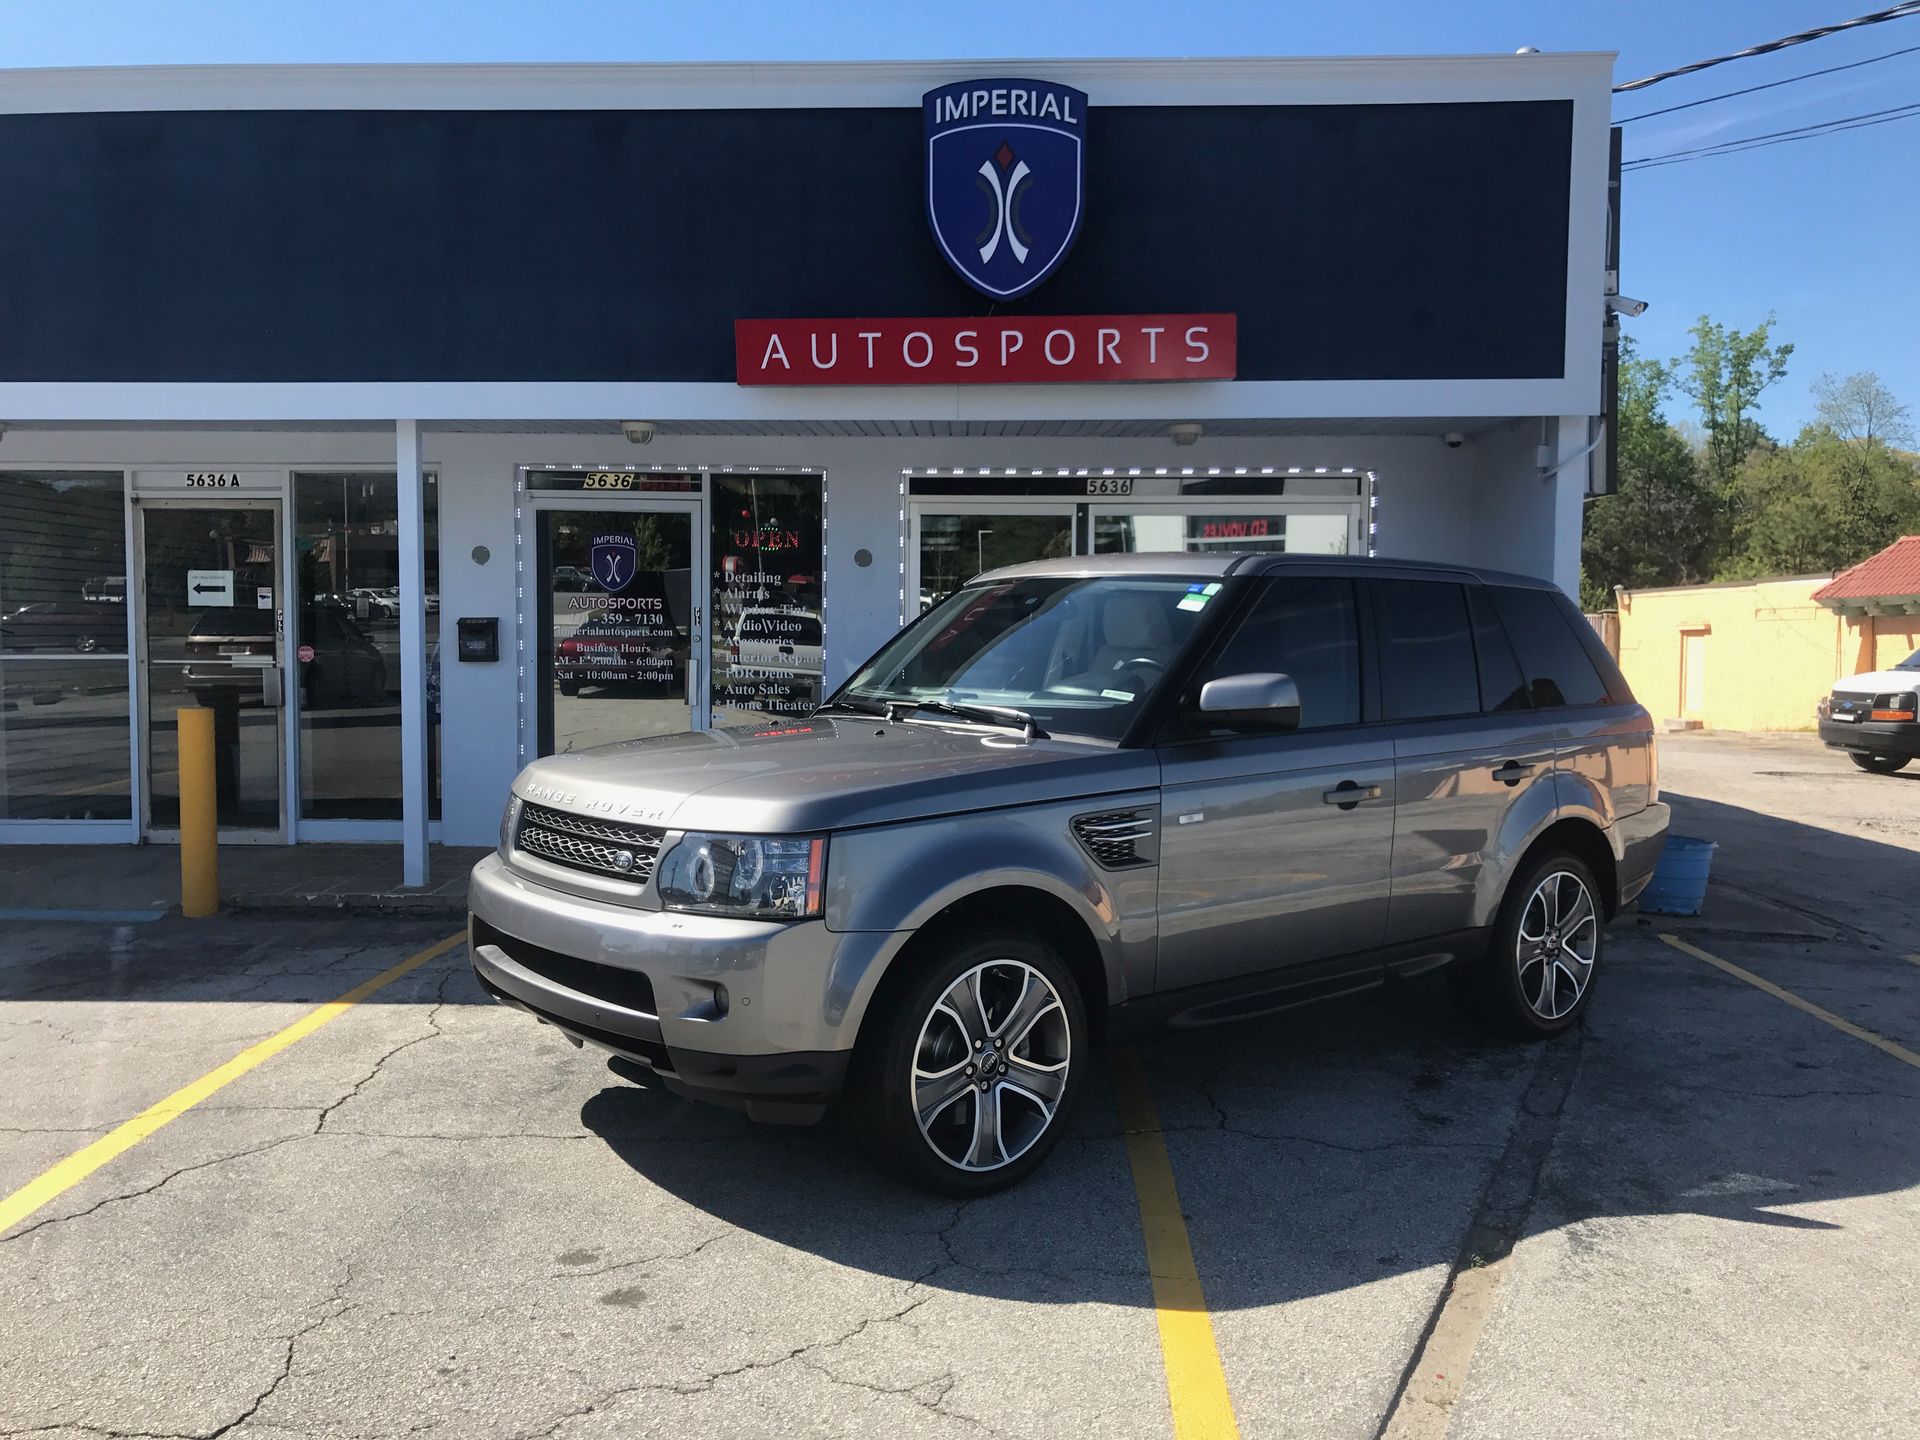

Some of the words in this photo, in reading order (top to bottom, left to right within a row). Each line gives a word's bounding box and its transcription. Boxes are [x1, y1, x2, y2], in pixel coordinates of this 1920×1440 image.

[935, 89, 1078, 124] IMPERIAL
[760, 326, 1210, 370] AUTOSPORTS
[585, 473, 632, 488] 5636
[1088, 480, 1129, 493] 5636
[593, 535, 635, 545] IMPERIAL
[735, 530, 799, 548] OPEN
[724, 571, 782, 586] Detailing
[723, 588, 770, 599] Alarms
[568, 597, 662, 610] AUTOSPORTS
[724, 604, 775, 615] Window
[781, 604, 806, 615] Tint
[601, 613, 623, 624] 359
[635, 613, 663, 625] 7130
[724, 635, 795, 647] Accessories
[576, 643, 618, 653] Business
[621, 643, 651, 653] Hours
[636, 657, 673, 668] 6:00pm
[725, 653, 773, 663] Interior
[779, 652, 819, 666] Repair
[557, 670, 574, 679] Sat
[587, 670, 628, 680] 10:00am
[637, 671, 674, 682] 2:00pm
[725, 667, 755, 679] PDR
[760, 667, 794, 679] Dents
[724, 684, 755, 695] Auto
[759, 683, 790, 695] Sales
[726, 699, 763, 711] Home
[766, 699, 816, 711] Theater
[526, 783, 577, 805] RANGE
[585, 800, 664, 820] ROVER
